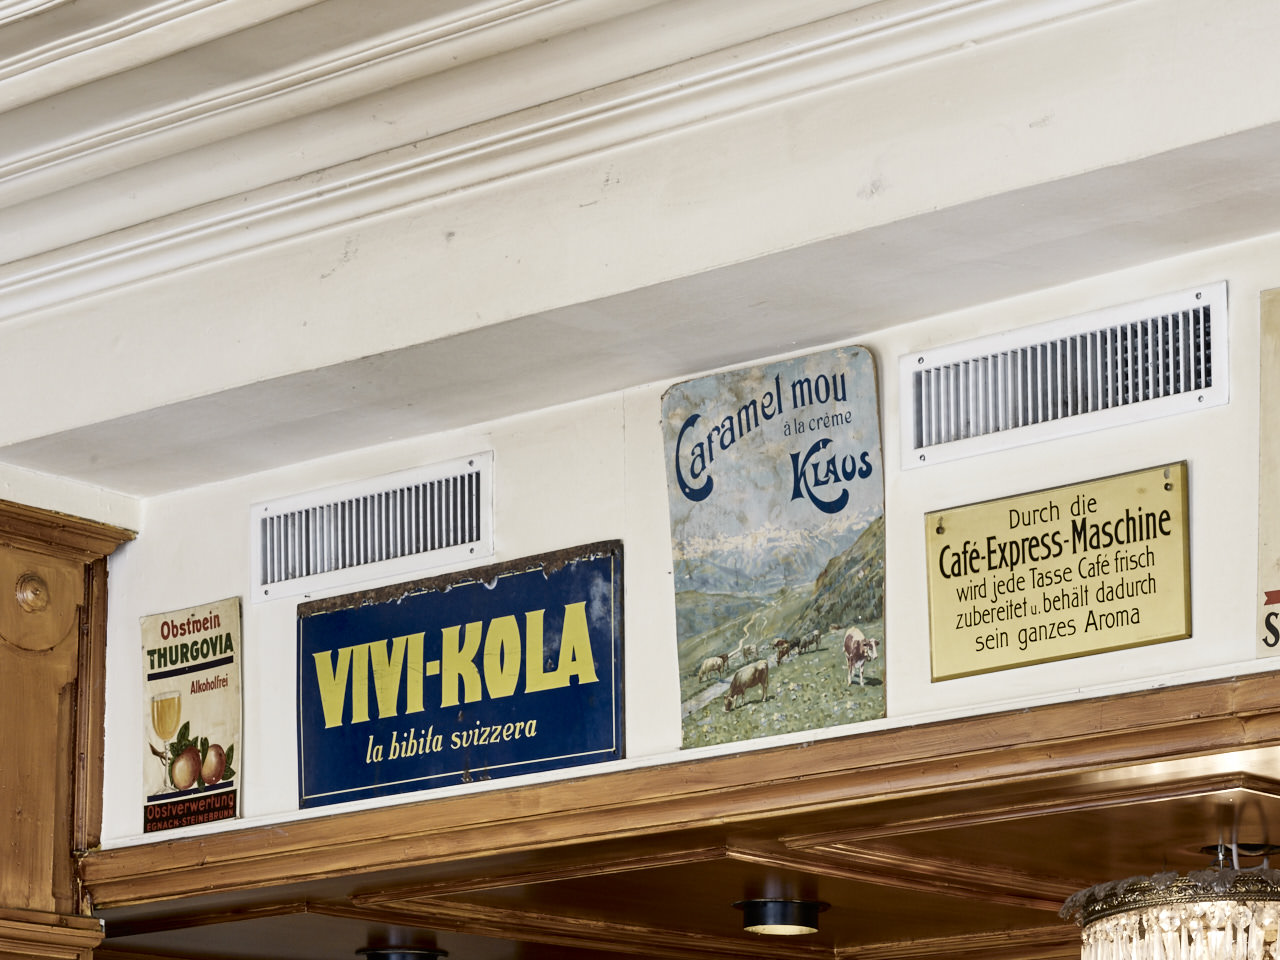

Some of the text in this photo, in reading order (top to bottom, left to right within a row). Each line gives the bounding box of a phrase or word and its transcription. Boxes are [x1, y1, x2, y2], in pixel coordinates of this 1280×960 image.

[675, 372, 847, 502] Caramel mou
[794, 418, 805, 434] la
[808, 410, 853, 432] crème
[1009, 494, 1098, 530] Durch die
[938, 507, 1172, 579] Café-Express-Maschine
[956, 545, 1155, 604] wird jede Tasse Café frisch
[955, 573, 1157, 630] zubereitet u. behält dadurch
[160, 610, 221, 641] Obstwein
[975, 607, 1141, 652] sein ganzes Aroma
[147, 632, 234, 671] THURGOVIA
[312, 601, 600, 729] VIVI-KOLA
[190, 673, 229, 695] Alkoholfrei
[365, 719, 537, 764] la bibita svizzera
[147, 793, 235, 819] Obstverwertung
